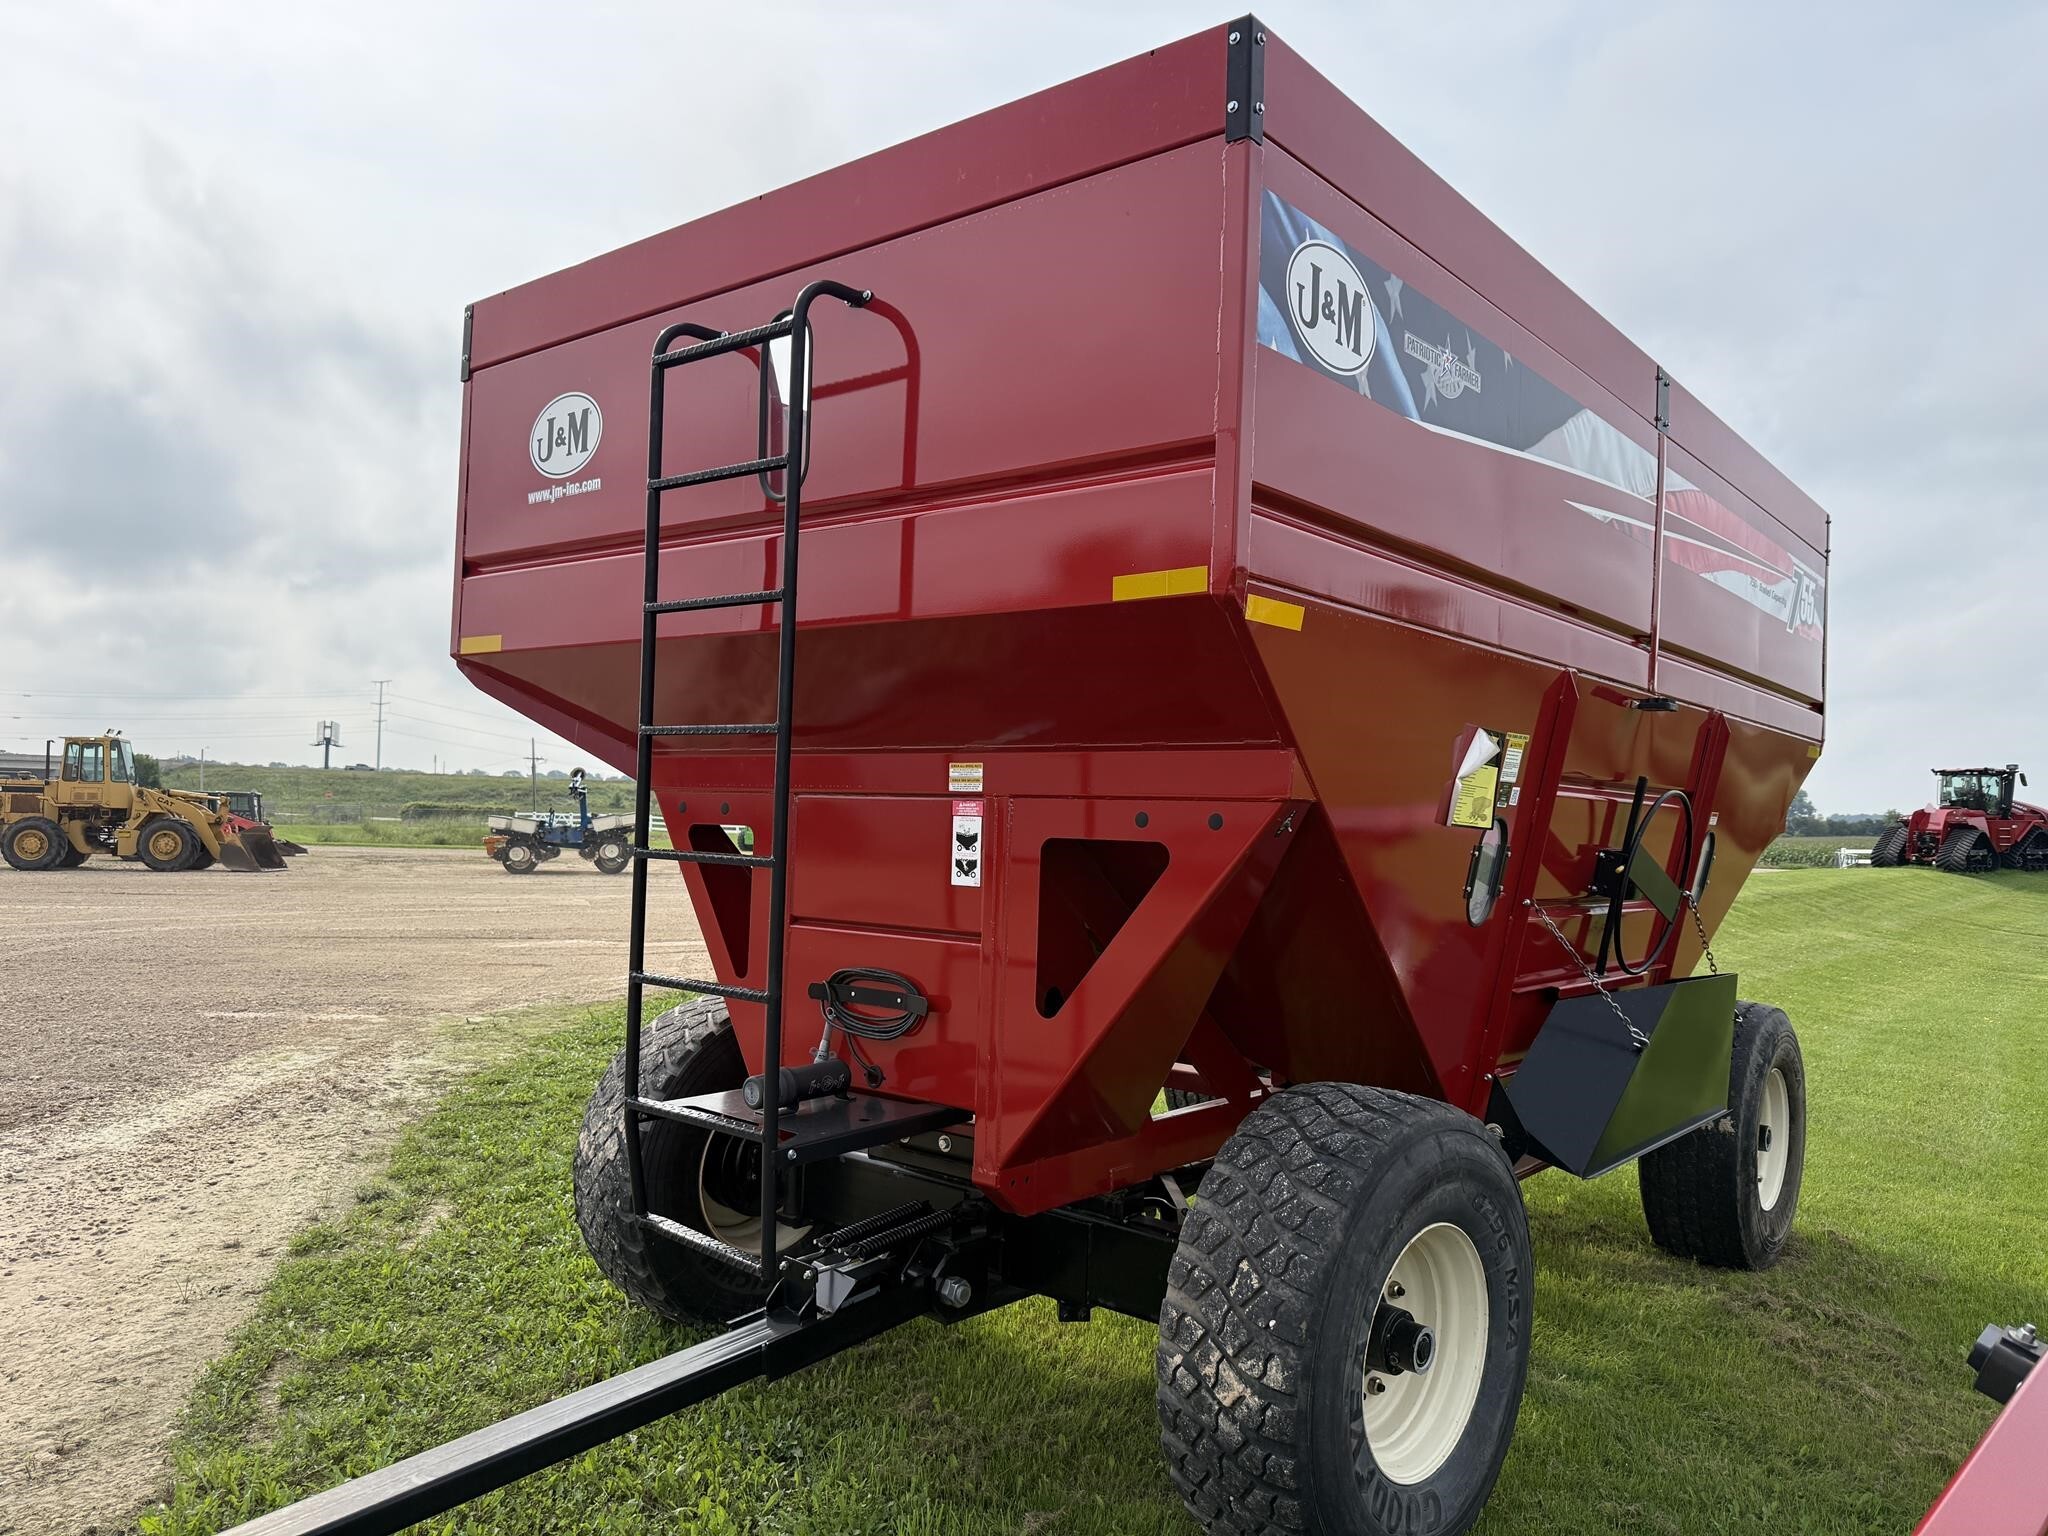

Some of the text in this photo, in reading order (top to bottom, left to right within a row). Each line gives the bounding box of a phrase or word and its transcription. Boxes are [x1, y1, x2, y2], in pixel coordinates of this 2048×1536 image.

[1296, 262, 1364, 358] J&M
[1407, 335, 1442, 368] PATRIOTIC
[1454, 363, 1480, 391] FARMER
[536, 407, 591, 463] J&M
[527, 478, 602, 505] www.jm-inc.com
[157, 796, 175, 807] CAT
